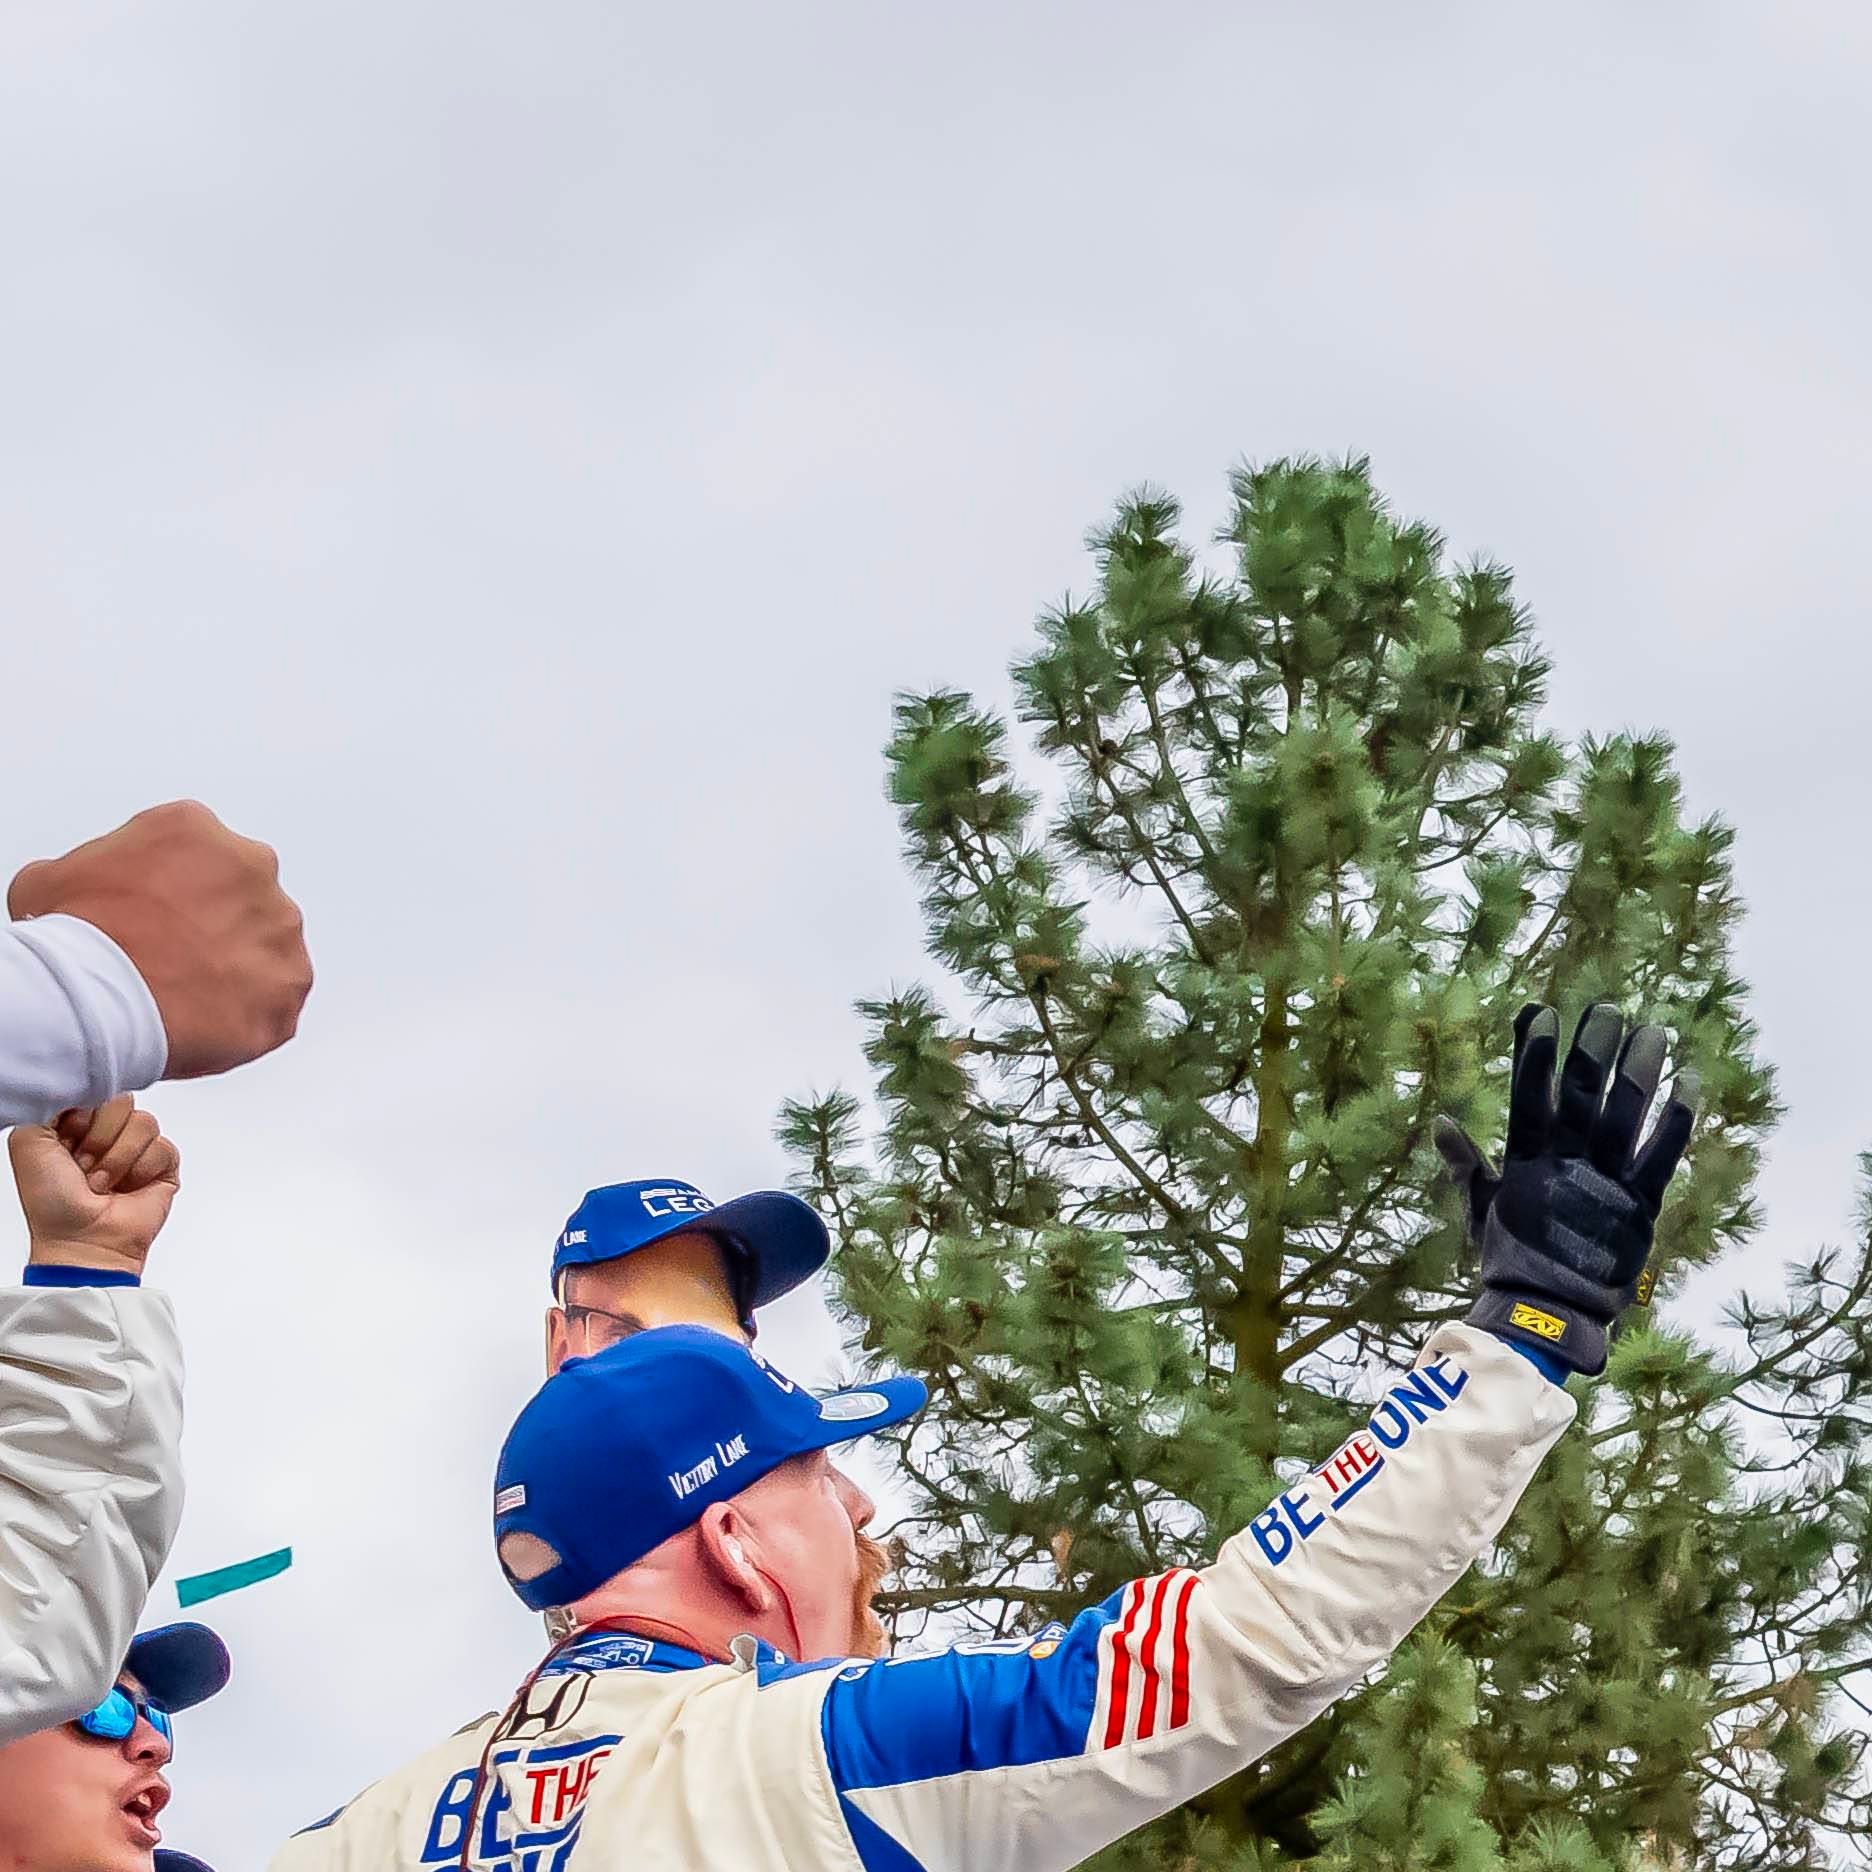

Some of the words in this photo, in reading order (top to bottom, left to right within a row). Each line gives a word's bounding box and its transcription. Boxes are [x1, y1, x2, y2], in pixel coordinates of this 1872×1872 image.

[1250, 1489, 1325, 1567] BE
[1315, 1437, 1379, 1494] THE
[1367, 1353, 1470, 1450] ONE
[420, 1749, 522, 1864] BE
[526, 1749, 613, 1825] THE
